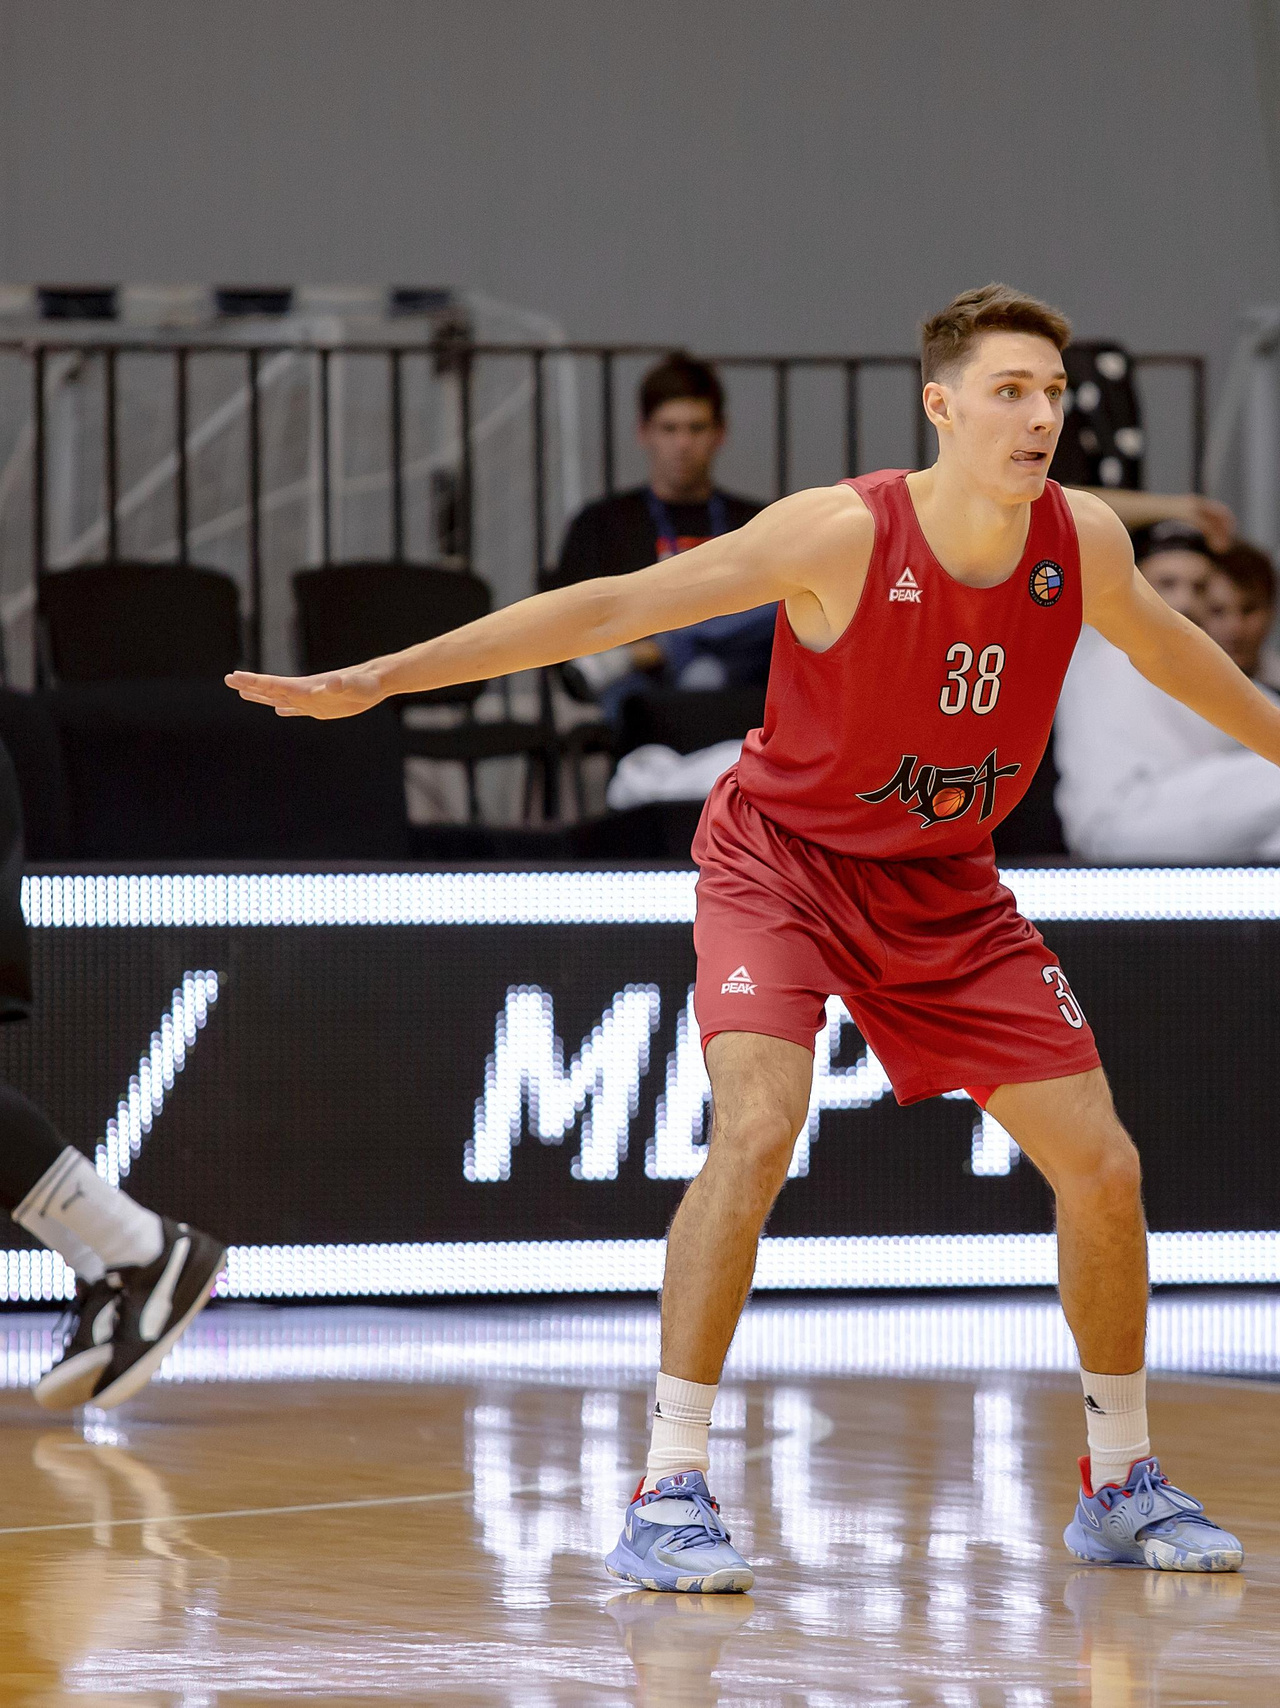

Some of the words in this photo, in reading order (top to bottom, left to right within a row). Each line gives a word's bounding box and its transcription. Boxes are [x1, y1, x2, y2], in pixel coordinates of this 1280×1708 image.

[888, 588, 923, 604] PEAK
[938, 641, 1006, 716] 38
[720, 982, 759, 996] PEAK
[1041, 965, 1088, 1029] 3
